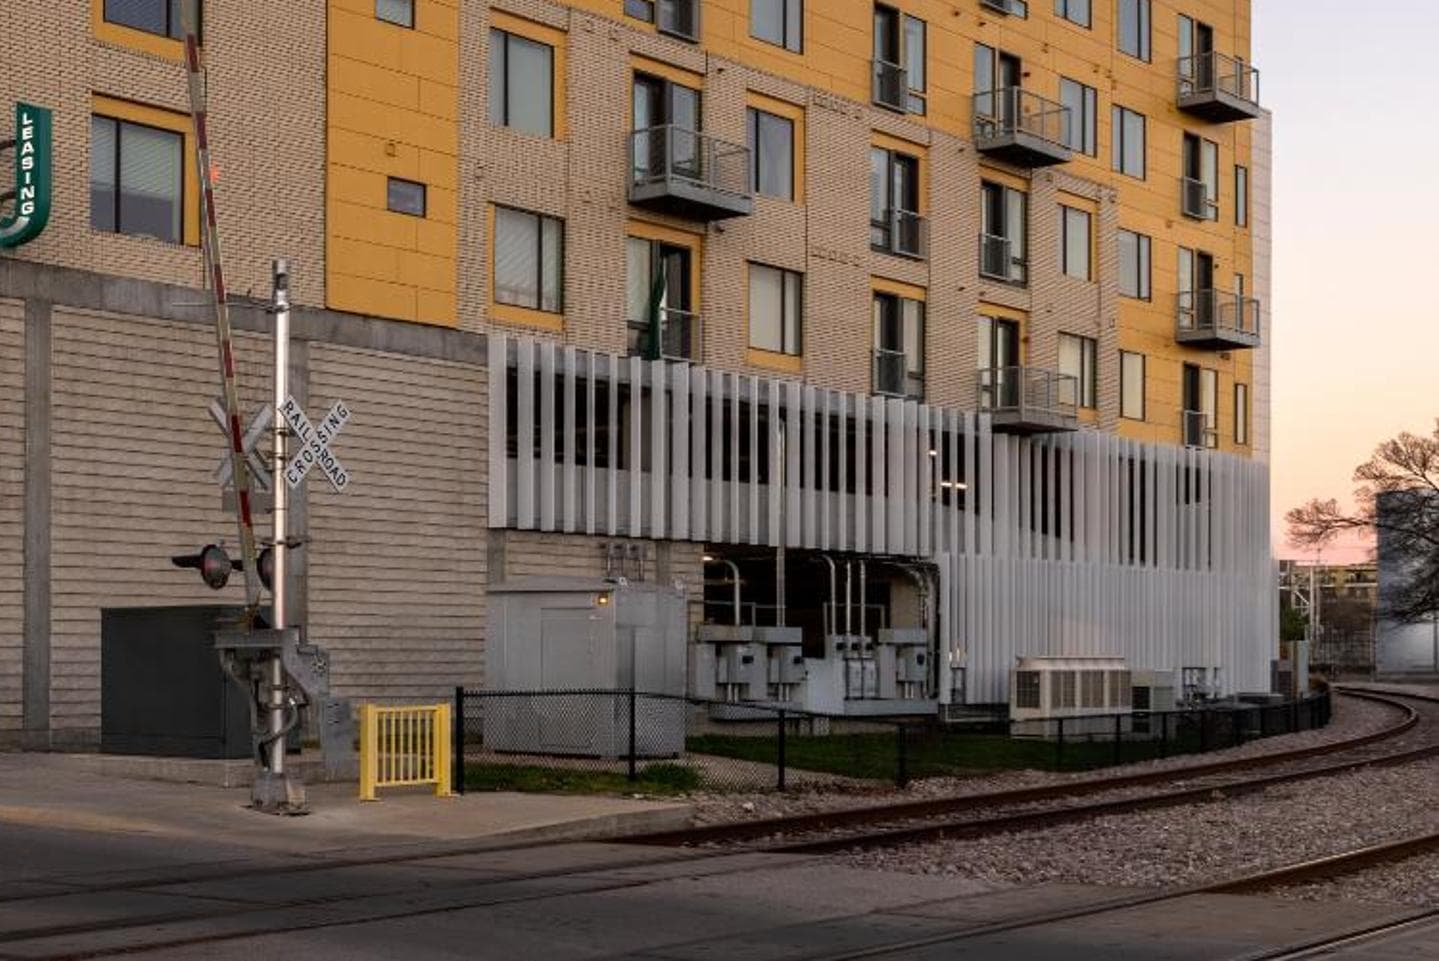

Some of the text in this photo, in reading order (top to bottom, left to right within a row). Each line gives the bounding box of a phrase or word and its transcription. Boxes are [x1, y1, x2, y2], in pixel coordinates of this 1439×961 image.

[20, 112, 35, 215] LEASING
[283, 400, 311, 441] RAIL
[286, 403, 348, 485] CROSSING
